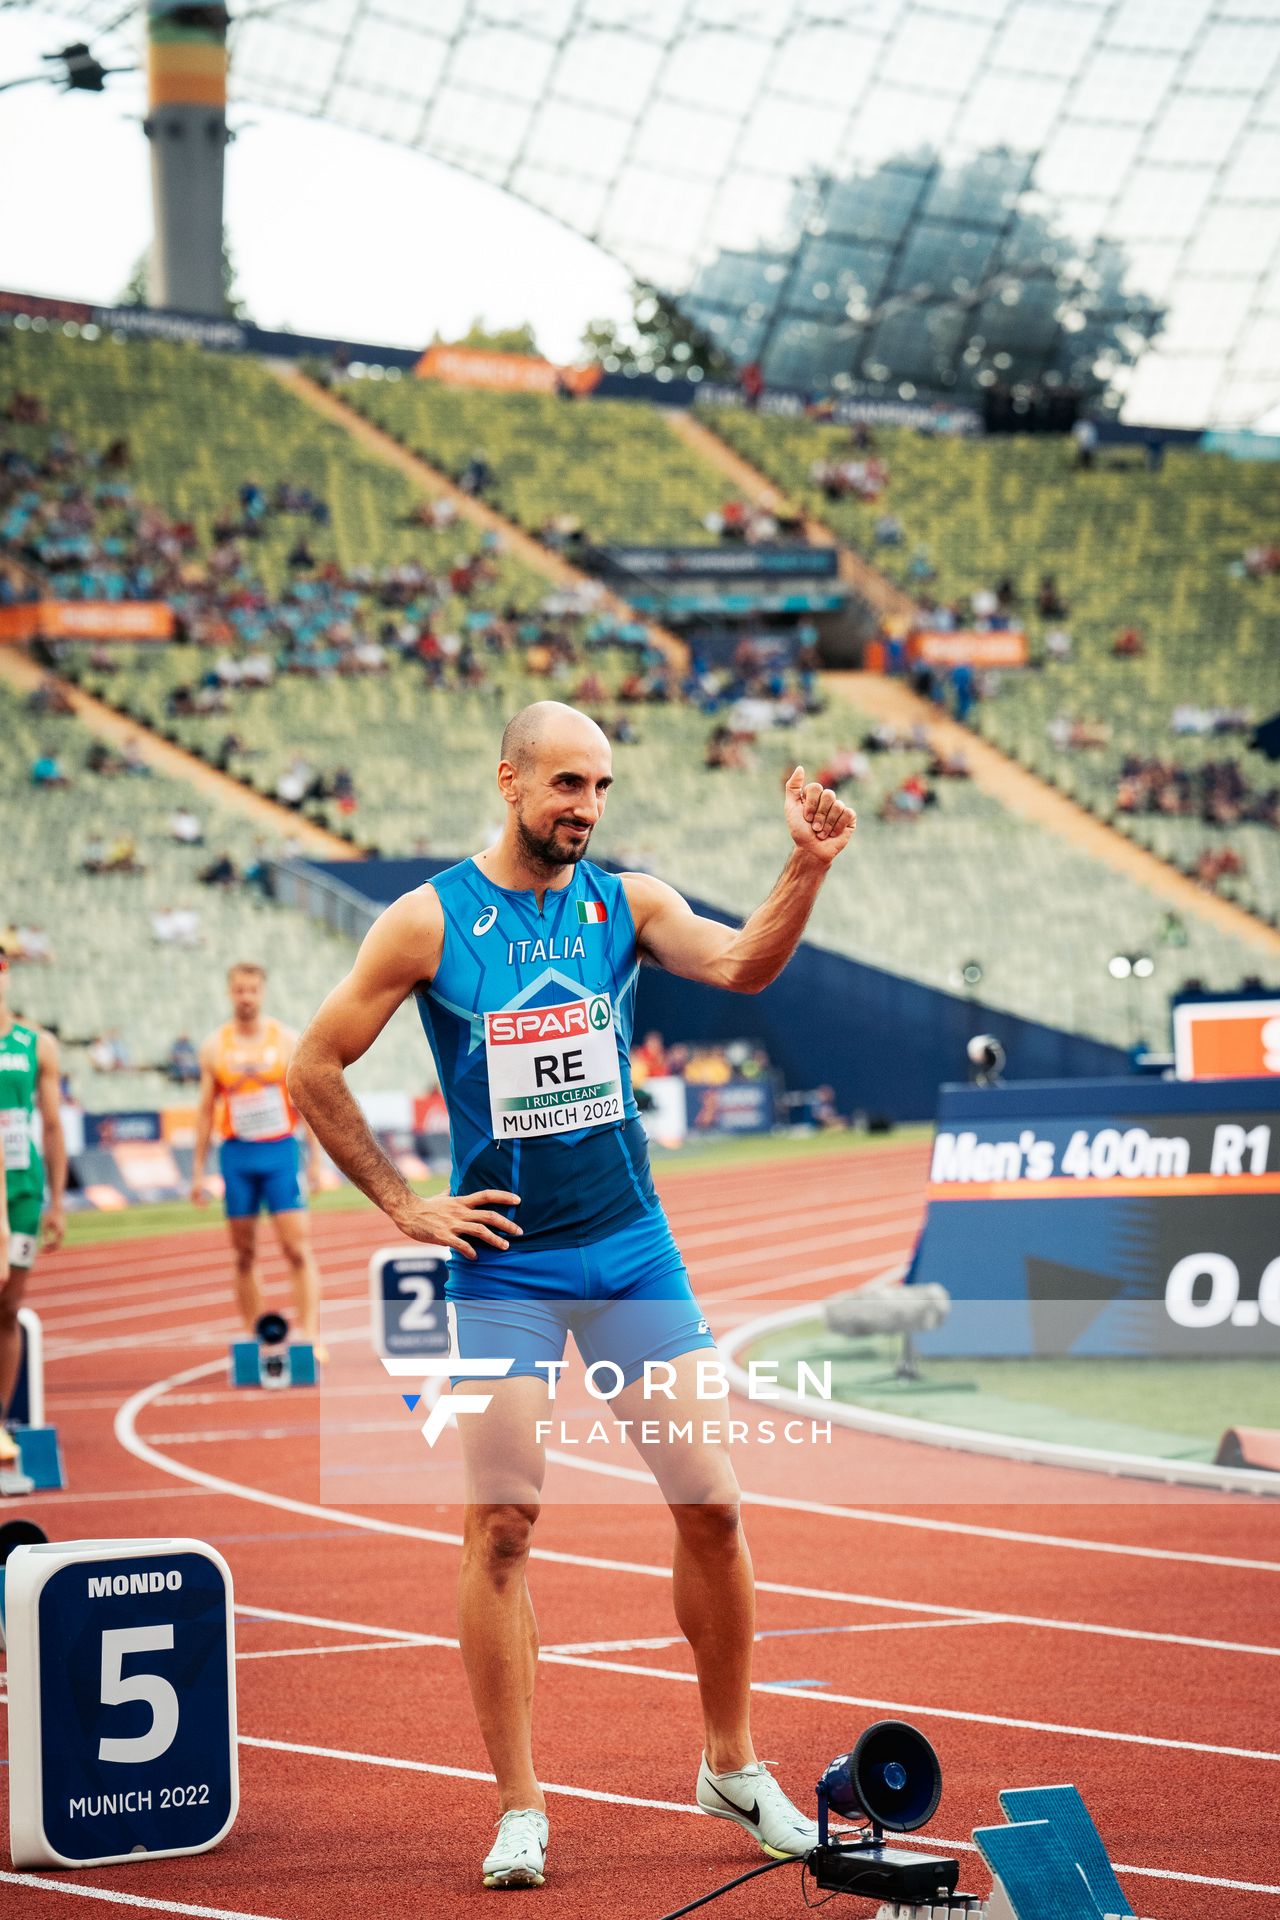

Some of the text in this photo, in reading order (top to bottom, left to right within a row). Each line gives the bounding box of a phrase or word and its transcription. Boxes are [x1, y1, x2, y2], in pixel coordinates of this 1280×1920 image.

[507, 936, 586, 965] ITALIA
[492, 1007, 587, 1041] SPAR
[534, 1050, 586, 1088] RE
[503, 1098, 619, 1132] MUNICH 2022
[533, 1094, 559, 1107] RUN
[931, 1124, 1271, 1183] Men's 400m R1
[398, 1276, 435, 1331] 2
[1165, 1252, 1280, 1328] 0.
[88, 1570, 182, 1598] MONDO
[98, 1624, 180, 1764] 5
[69, 1783, 210, 1819] MUNICH 2022
